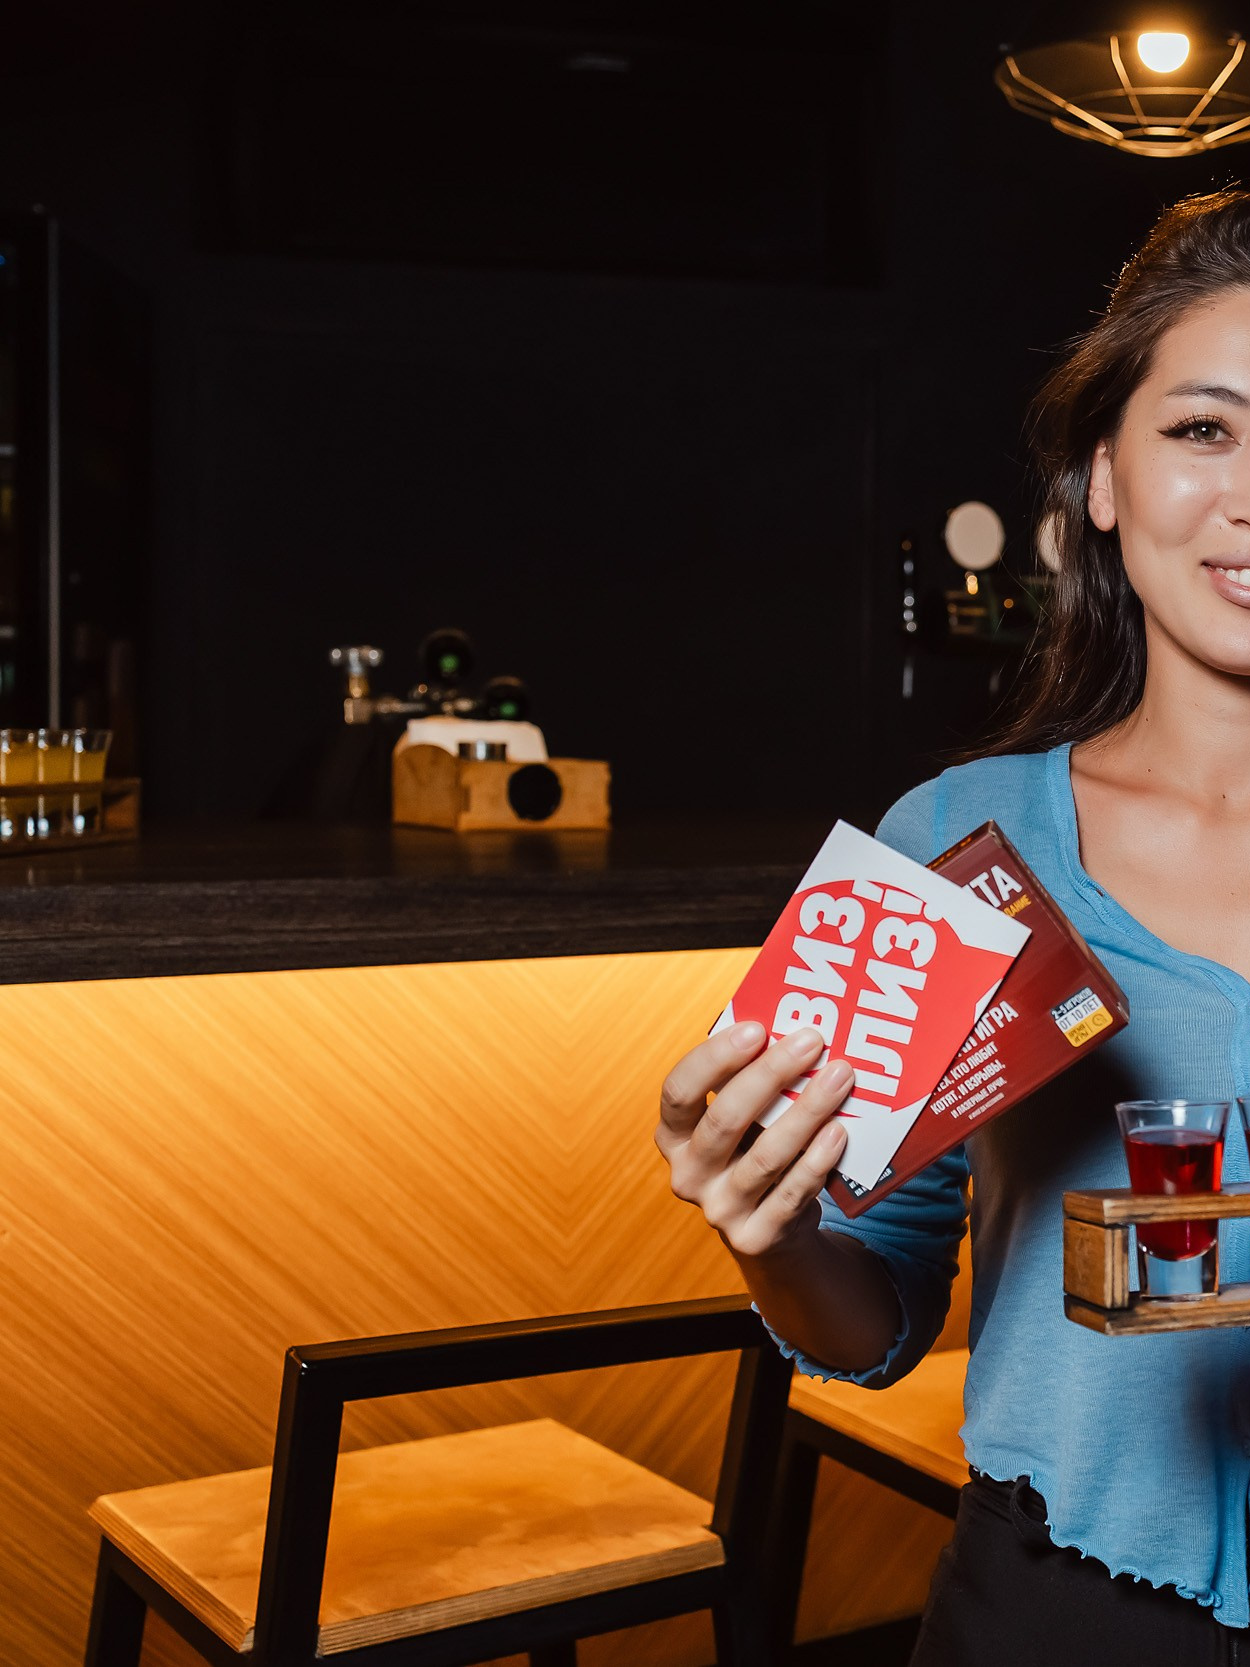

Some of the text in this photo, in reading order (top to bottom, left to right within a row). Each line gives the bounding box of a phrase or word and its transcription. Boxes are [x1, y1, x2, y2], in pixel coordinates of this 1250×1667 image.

[961, 864, 1023, 908] ТА
[768, 879, 885, 1095] ВИЗ,
[974, 1001, 1020, 1042] ИГРА
[1059, 997, 1099, 1031] ОТ 10 ЛЕТ
[950, 1062, 970, 1080] КТО
[966, 1041, 999, 1069] ЛЮБИТ
